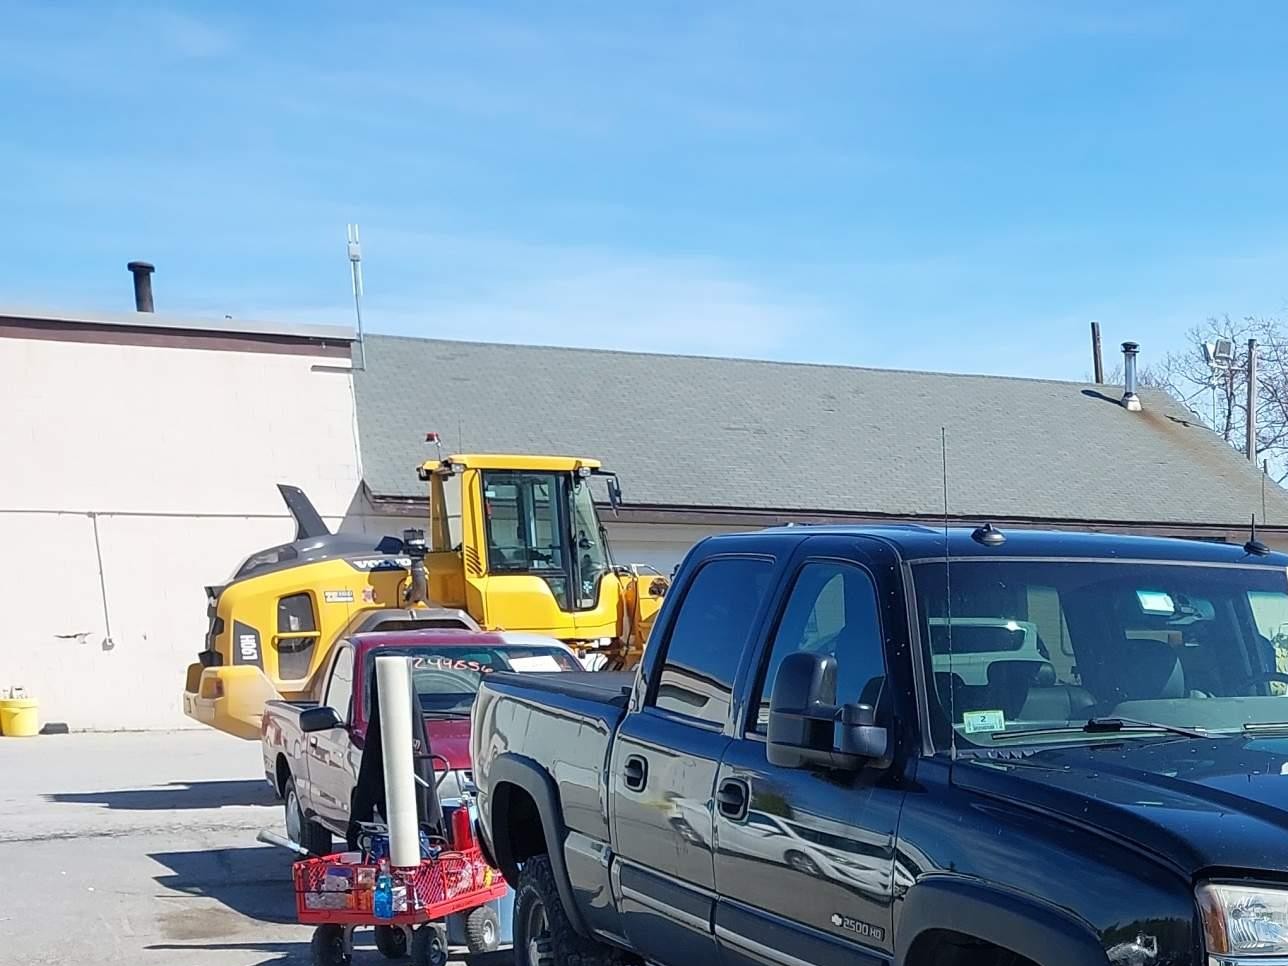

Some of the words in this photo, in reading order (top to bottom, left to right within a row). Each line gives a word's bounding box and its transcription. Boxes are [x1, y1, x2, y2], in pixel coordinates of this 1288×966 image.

[353, 558, 412, 569] VOLVO
[240, 634, 258, 660] L90H
[843, 917, 869, 936] 2500
[870, 927, 882, 940] HD
